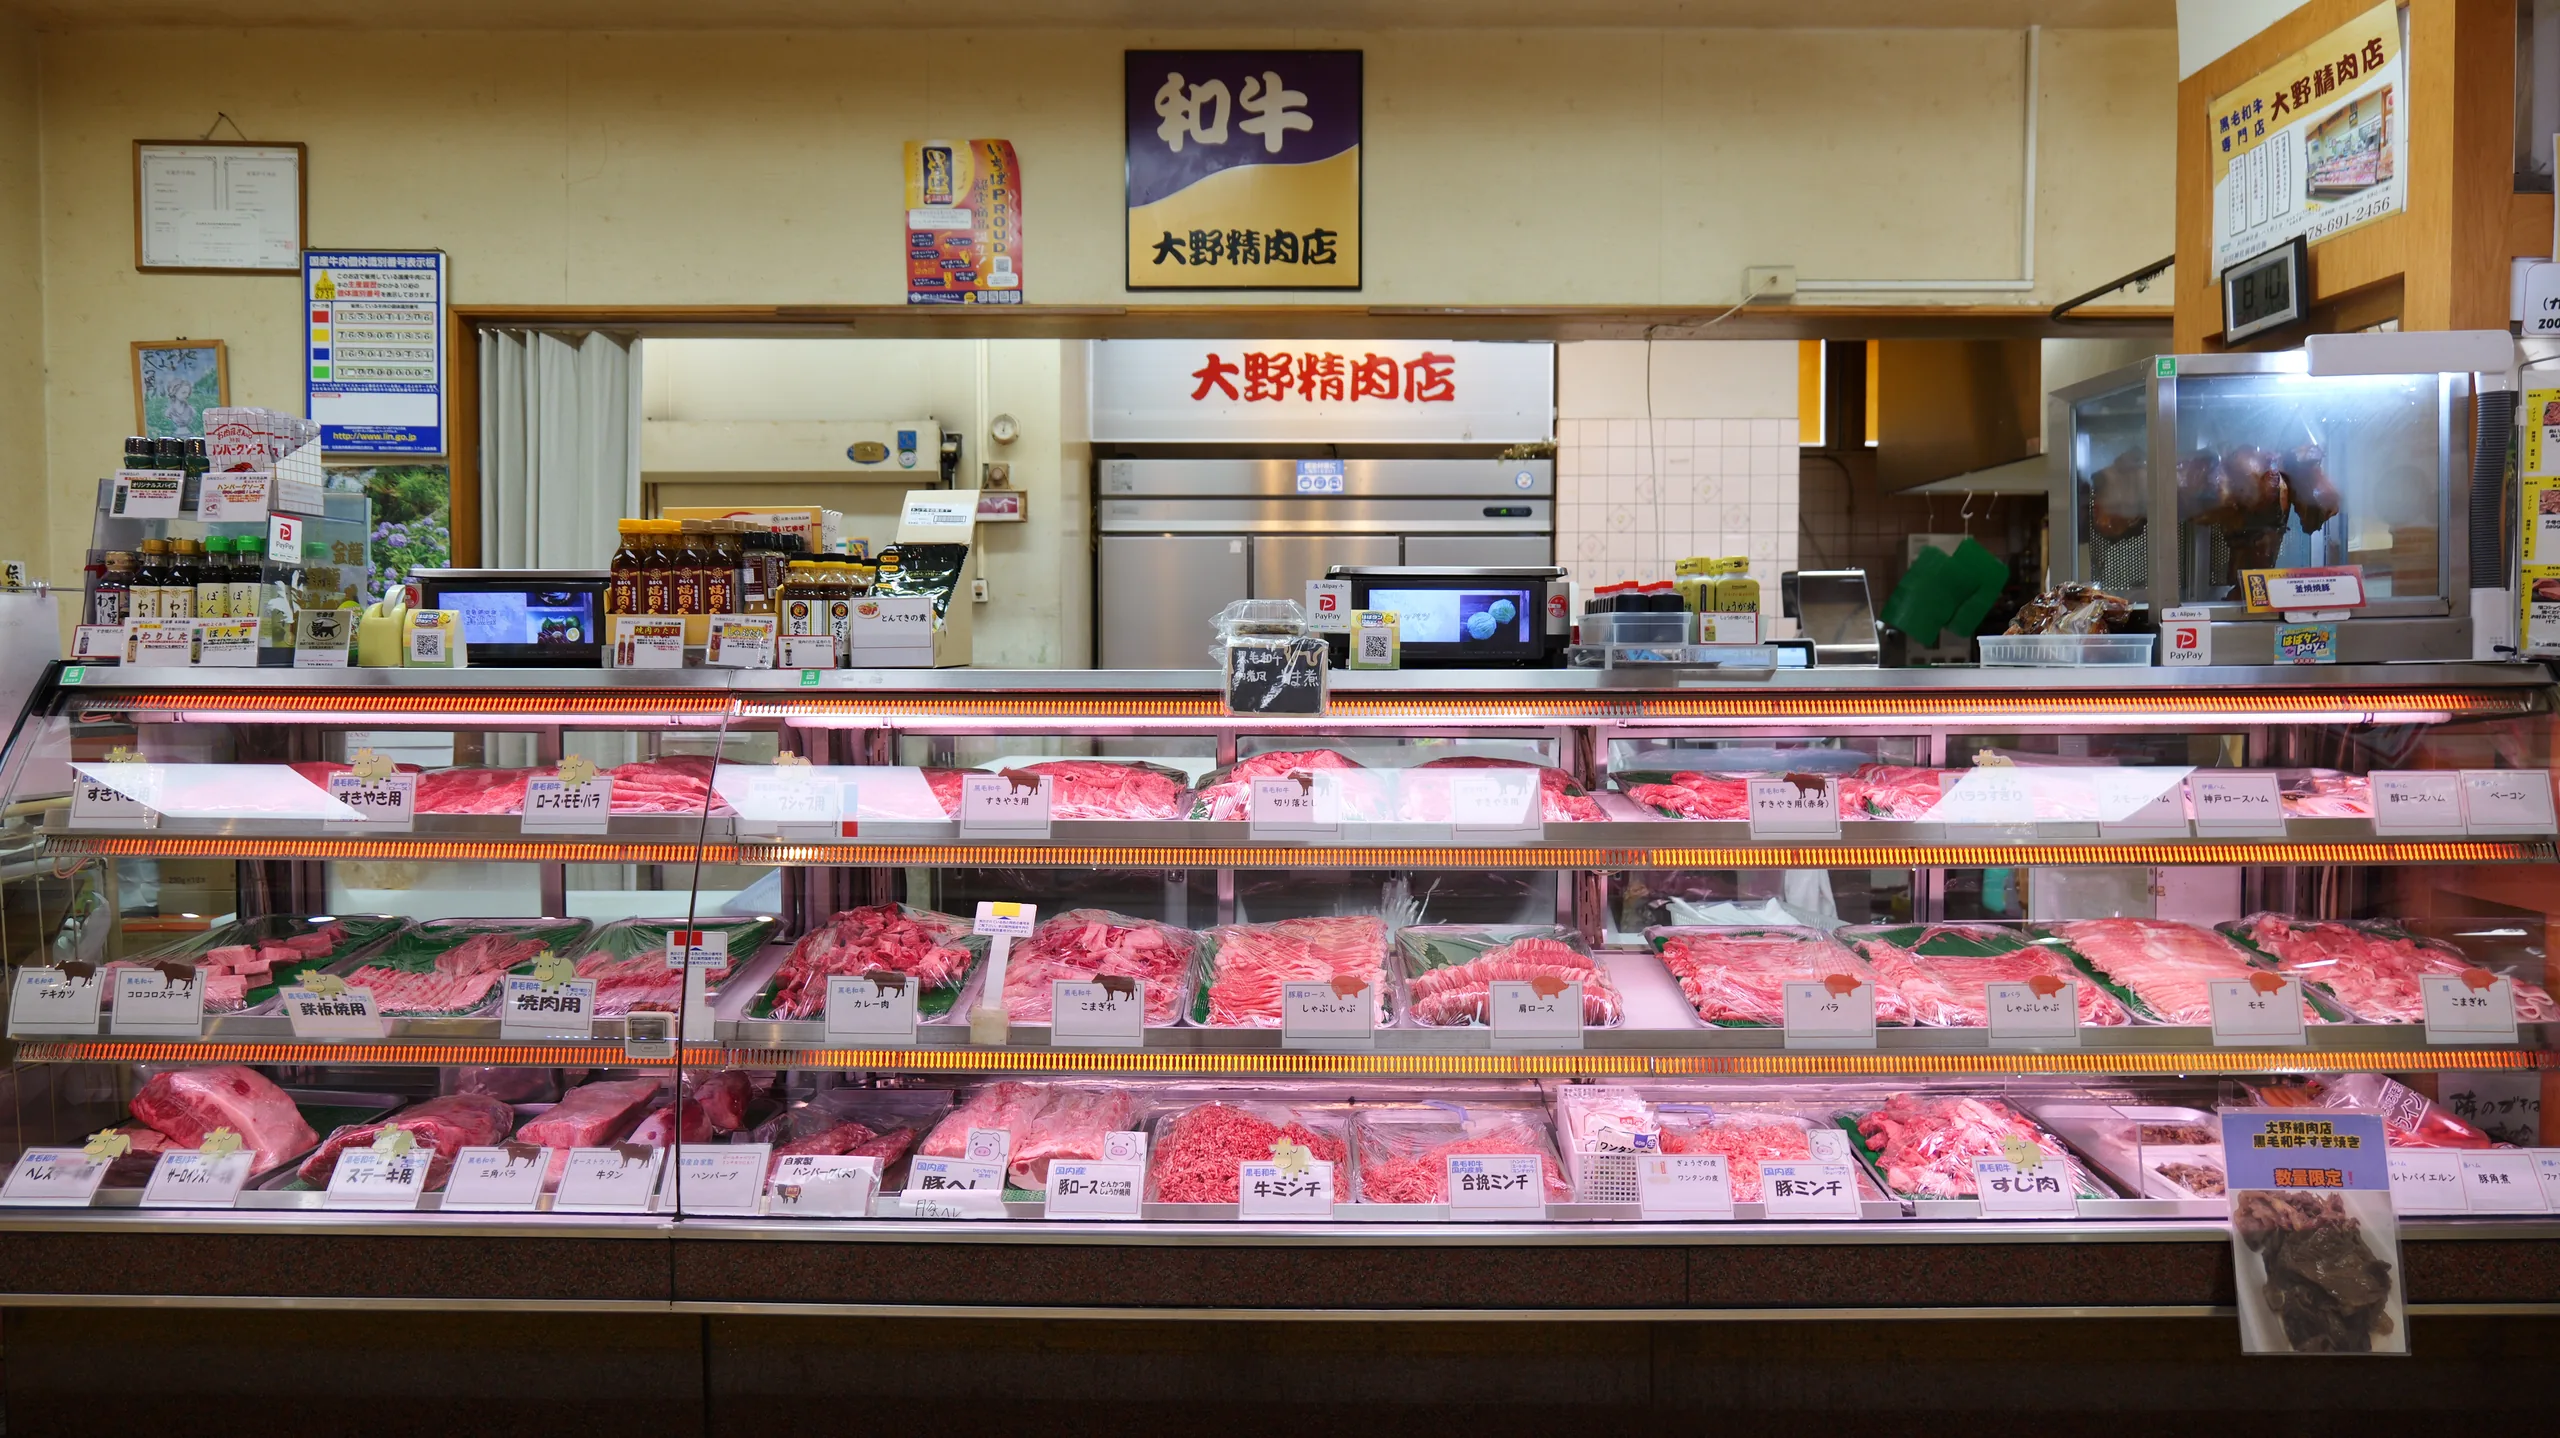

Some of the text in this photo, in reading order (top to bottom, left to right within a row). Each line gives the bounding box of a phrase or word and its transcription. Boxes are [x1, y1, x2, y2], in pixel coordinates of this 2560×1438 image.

[2271, 37, 2385, 121] 大野精肉店
[1155, 71, 1313, 153] 和牛
[2220, 98, 2264, 134] 黒毛和牛
[1152, 228, 1337, 265] 大野精肉店
[309, 255, 437, 268] 国産牛肉個体識別番号表示板
[1191, 351, 1456, 402] 大野精肉店
[332, 432, 417, 441] http://www.lin.go.jp
[275, 541, 295, 550] PayPay
[881, 614, 927, 622] とんてきの素
[1315, 612, 1341, 621] PayPay
[142, 631, 188, 640] わりした
[635, 627, 678, 635] 焼肉のたれ
[2282, 632, 2320, 647] はばタン
[2170, 651, 2203, 660] PayPay
[333, 779, 361, 787] 黒毛和牛
[532, 782, 561, 791] 黒毛和牛
[974, 784, 1001, 792] 黒毛和牛
[1262, 786, 1290, 794] 黒毛和牛
[1758, 787, 1787, 796] 黒毛和牛
[339, 790, 402, 807] すきやき用
[537, 792, 600, 809] ロース・モモ・バラ
[2203, 794, 2270, 803] 神戸ロースハム
[2390, 793, 2446, 803] 醇ロースハム
[2490, 791, 2527, 800] ベーコン
[985, 796, 1030, 806] すきやき用
[1274, 797, 1318, 807] 切り落とし
[1758, 799, 1830, 809] すきやき用(赤身)
[26, 977, 55, 985] 黒毛和牛
[126, 977, 154, 985] 黒毛和牛
[511, 981, 541, 991] 黒毛和牛
[838, 986, 866, 995] 黒毛和牛
[1063, 988, 1092, 997] 黒毛和牛
[2230, 987, 2238, 996] 豚
[2442, 984, 2450, 993] 豚
[39, 989, 76, 999] テキカツ
[127, 991, 192, 999] コロコロステーキ
[288, 992, 318, 1000] 黒毛和牛
[1288, 990, 1326, 999] 豚肩ロース
[1511, 990, 1519, 999] 豚
[1805, 990, 1813, 999] 豚
[2000, 990, 2021, 999] 豚バラ
[517, 994, 581, 1013] 焼肉用
[853, 999, 890, 1009] カレー肉
[1081, 1001, 1117, 1012] こまぎれ
[2248, 1001, 2266, 1010] モモ
[2452, 997, 2488, 1007] こまぎれ
[300, 1002, 367, 1016] 鉄板焼用
[1301, 1003, 1356, 1013] しゃぶしゃぶ
[1518, 1003, 1555, 1013] 肩ロース
[1820, 1003, 1839, 1012] バラ
[2006, 1003, 2060, 1013] しゃぶしゃぶ
[2265, 1121, 2333, 1135] 大野精肉店
[2253, 1135, 2361, 1149] 黒毛和牛すき焼き
[1600, 1142, 1636, 1154] ワンタン
[26, 1153, 59, 1162] 黒毛和牛
[166, 1155, 198, 1164] 黒毛和牛
[345, 1155, 376, 1164] 黒毛和牛
[468, 1156, 496, 1165] 黒毛和牛
[572, 1158, 620, 1166] オーストラリア
[784, 1156, 814, 1166] 自家製
[916, 1161, 949, 1173] 国内産
[1676, 1159, 1717, 1168] ぎょうざの皮
[1979, 1163, 2012, 1173] 黒毛和牛
[346, 1167, 414, 1184] ステーキ用
[480, 1168, 517, 1179] 三角バラ
[596, 1169, 623, 1180] 牛タン
[691, 1171, 739, 1180] ハンバーグ
[1055, 1166, 1087, 1176] 国内産
[1245, 1168, 1277, 1177] 黒毛和牛
[1763, 1167, 1795, 1176] 国内産
[1461, 1173, 1529, 1191] 合挽ミンチ
[1677, 1174, 1719, 1182] ワンタンの皮
[2478, 1173, 2511, 1184] 豚角煮
[1058, 1178, 1132, 1195] 豚ロース とんかつ用
[1254, 1181, 1321, 1198] 牛ミンチ
[1775, 1180, 1842, 1197] 豚ミンチ
[1991, 1176, 2060, 1193] すじ肉
